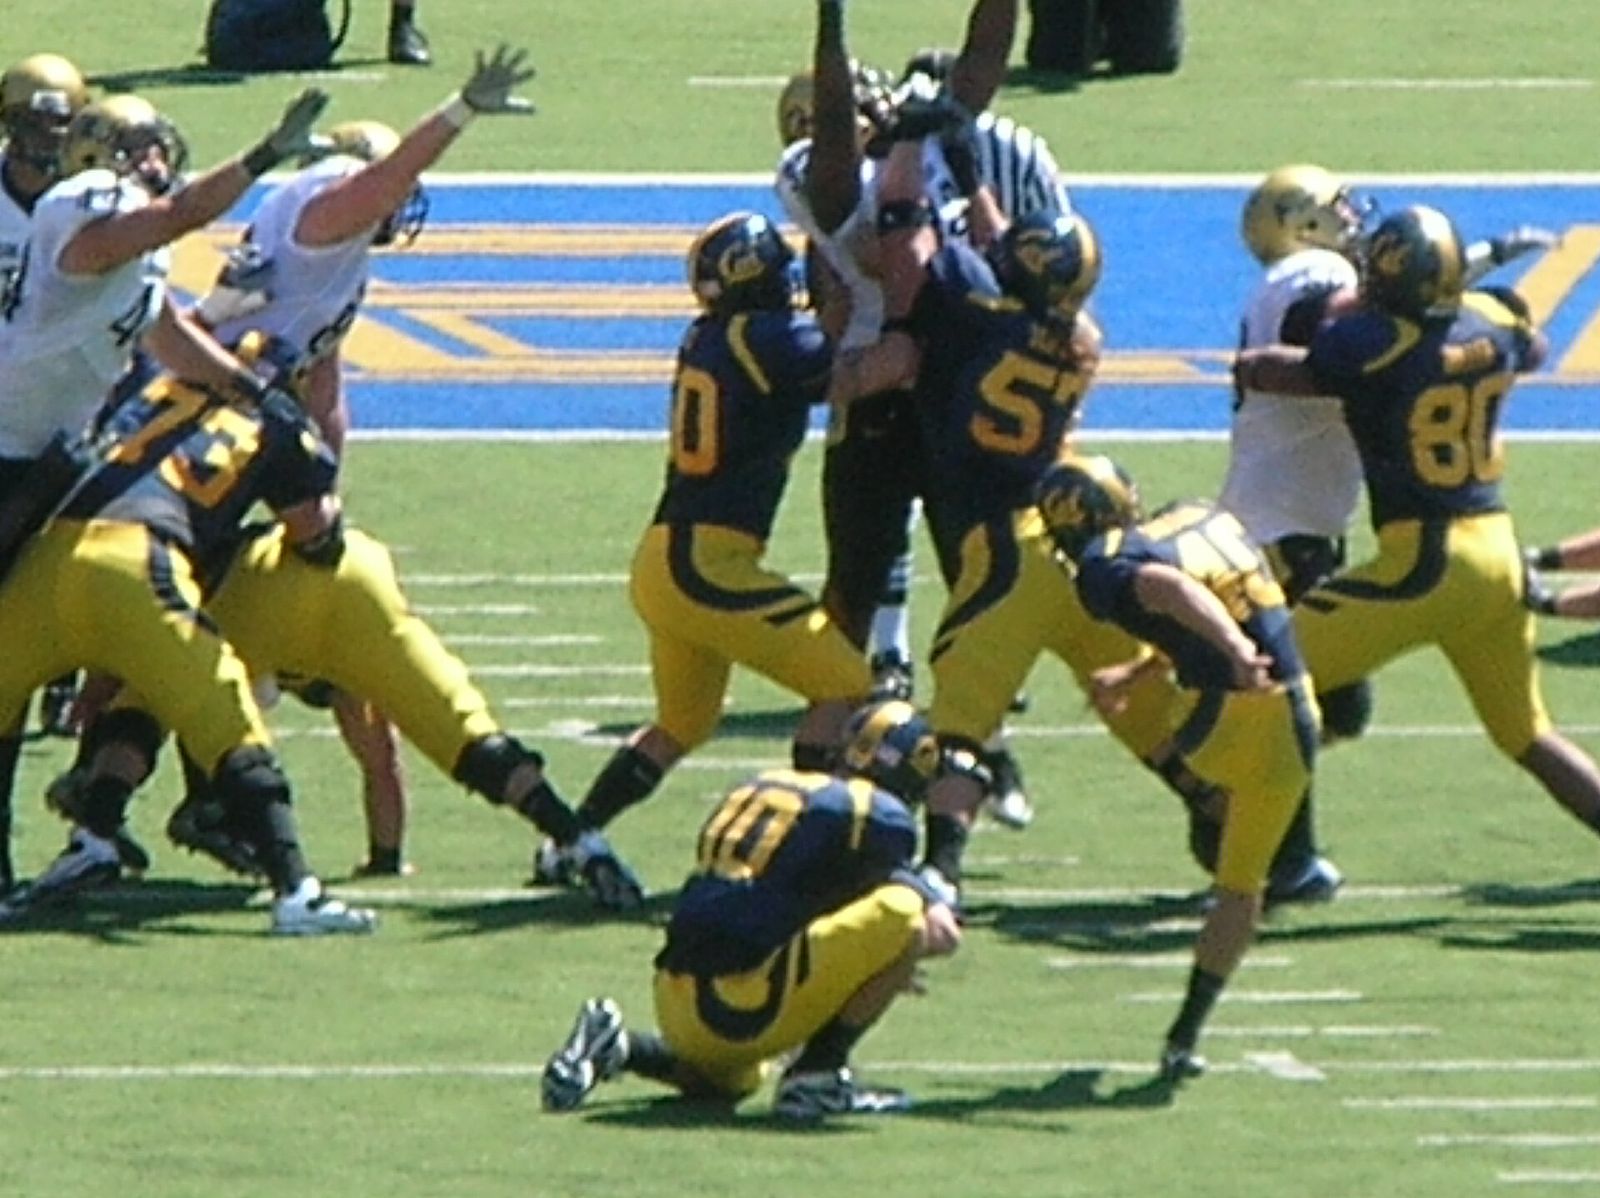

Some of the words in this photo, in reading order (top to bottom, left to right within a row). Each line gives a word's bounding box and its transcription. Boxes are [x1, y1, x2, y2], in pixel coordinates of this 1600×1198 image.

[105, 371, 263, 509] 73
[1411, 371, 1515, 488] 80
[698, 784, 804, 880] 10
